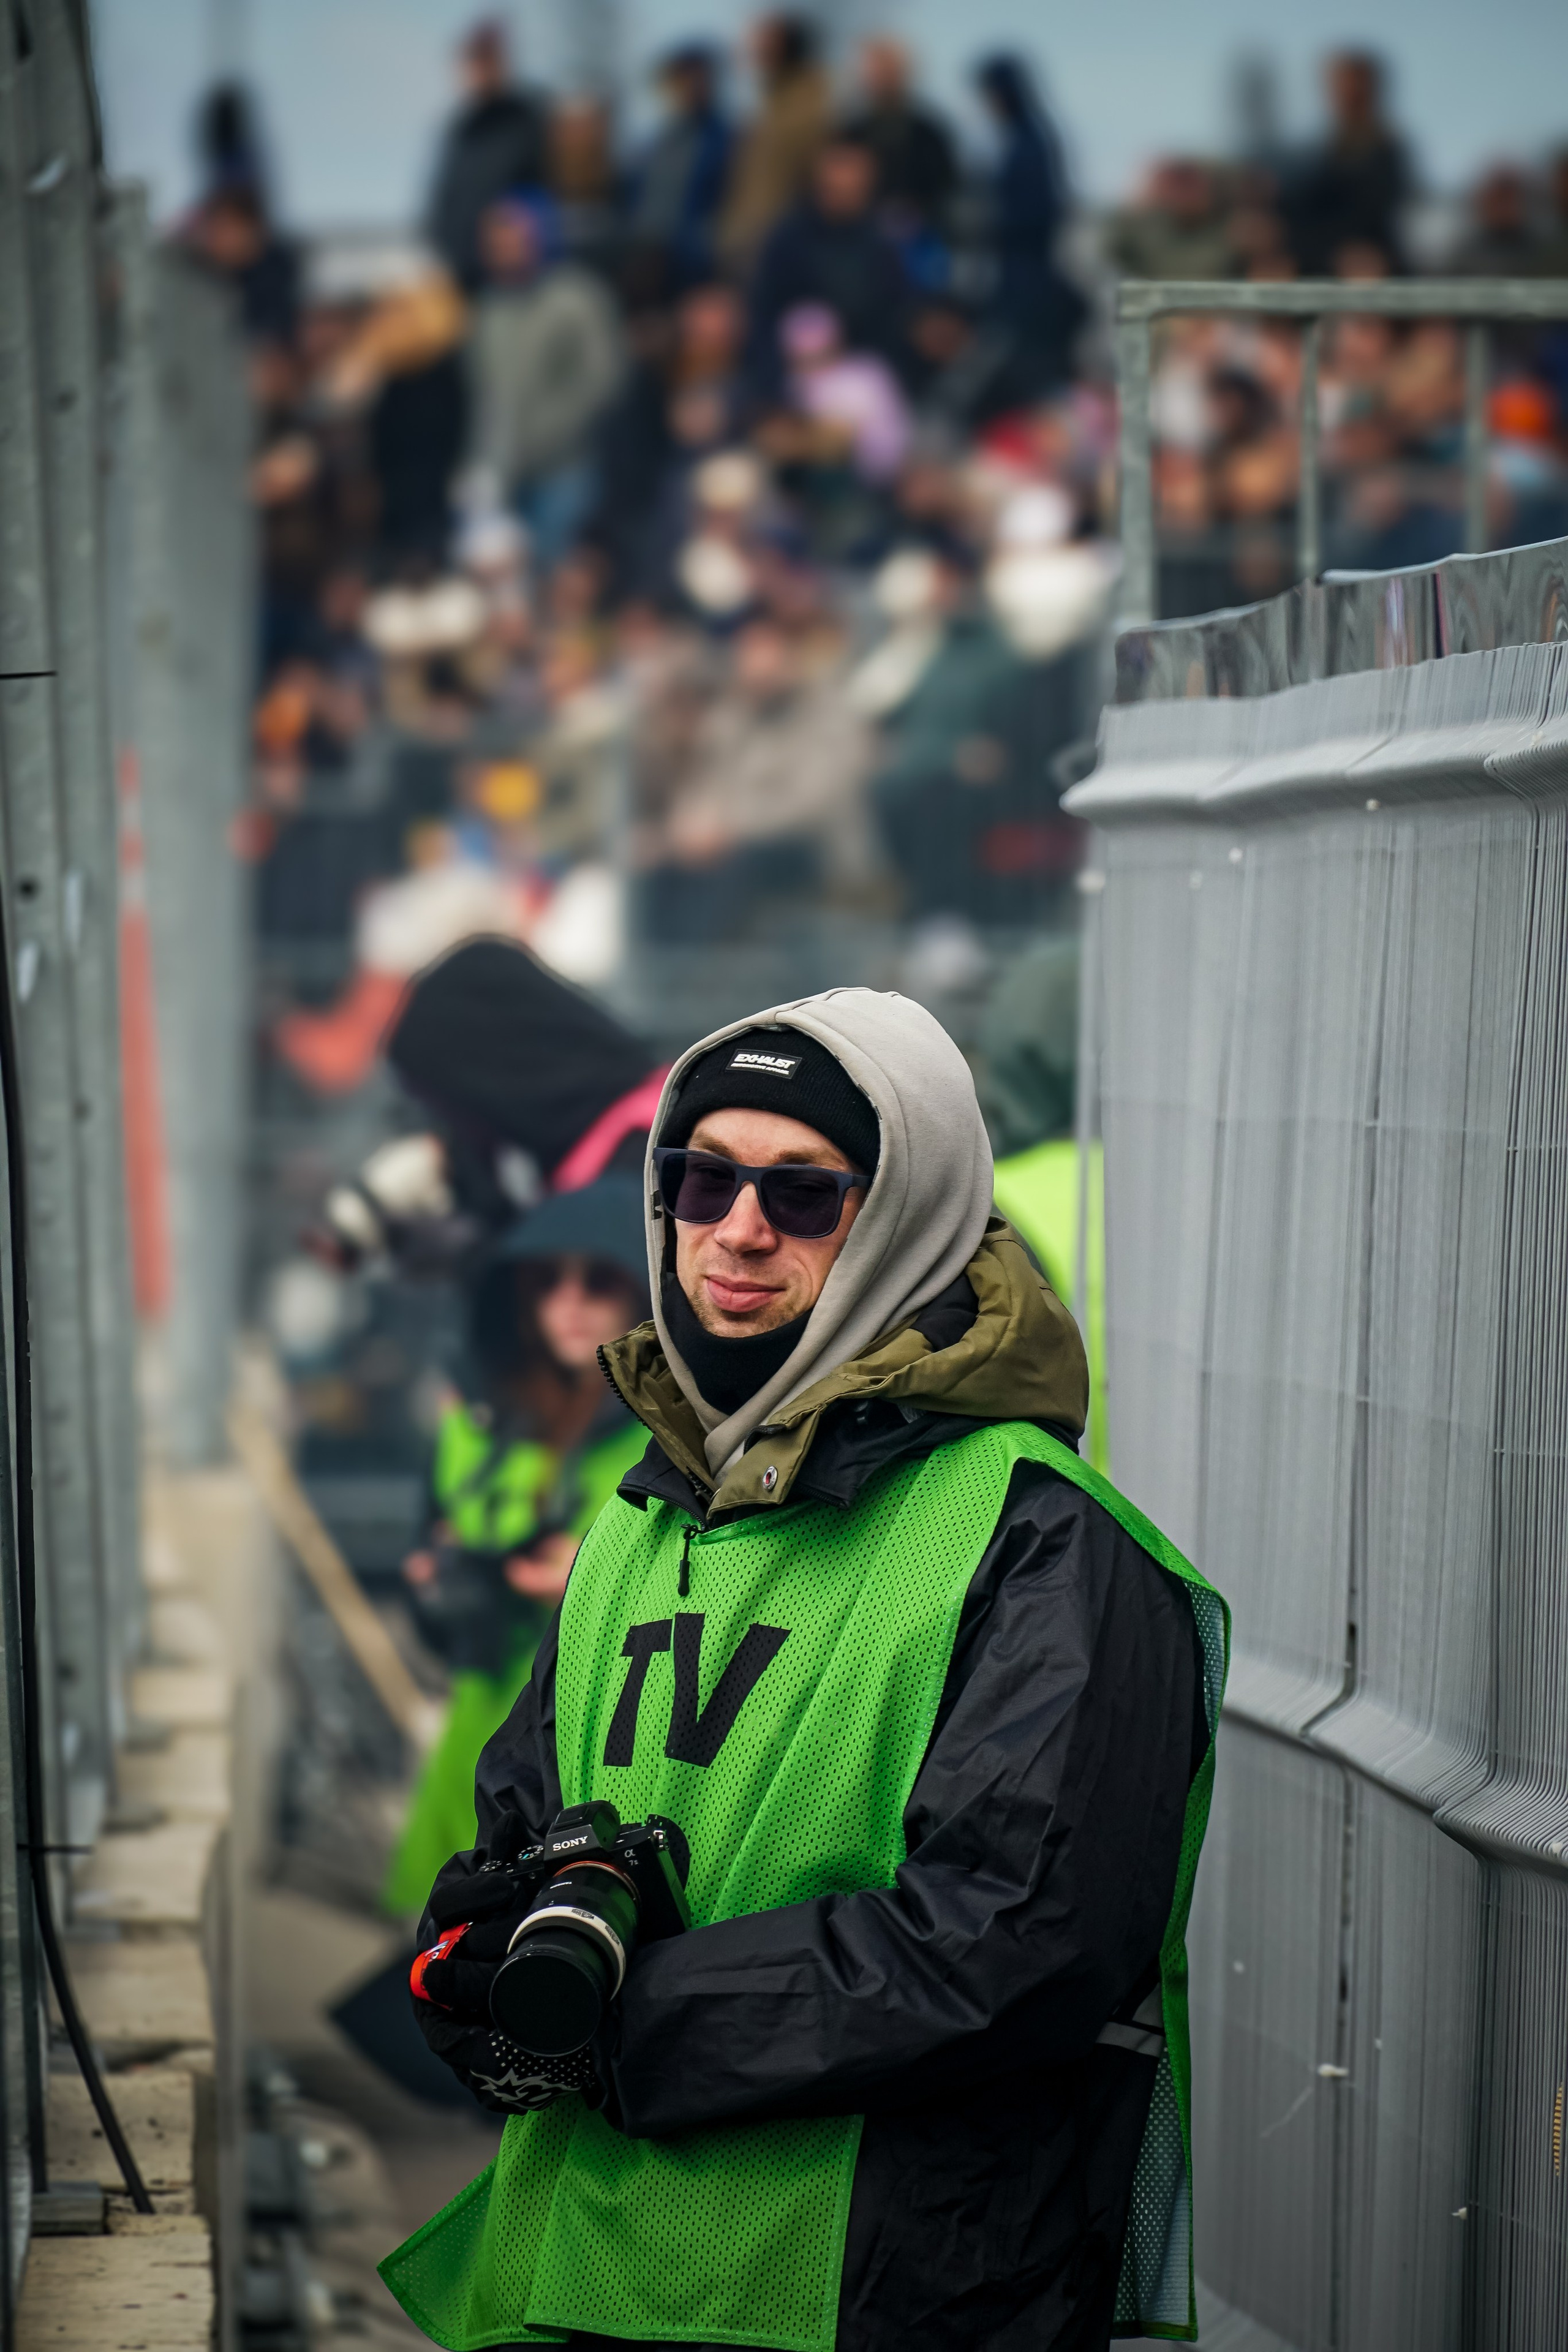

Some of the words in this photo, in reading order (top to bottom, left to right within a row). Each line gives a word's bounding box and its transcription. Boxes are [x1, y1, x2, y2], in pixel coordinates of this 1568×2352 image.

[734, 1054, 796, 1069] EXHAUST
[603, 1612, 793, 1768] TV
[552, 1836, 588, 1852] SONY
